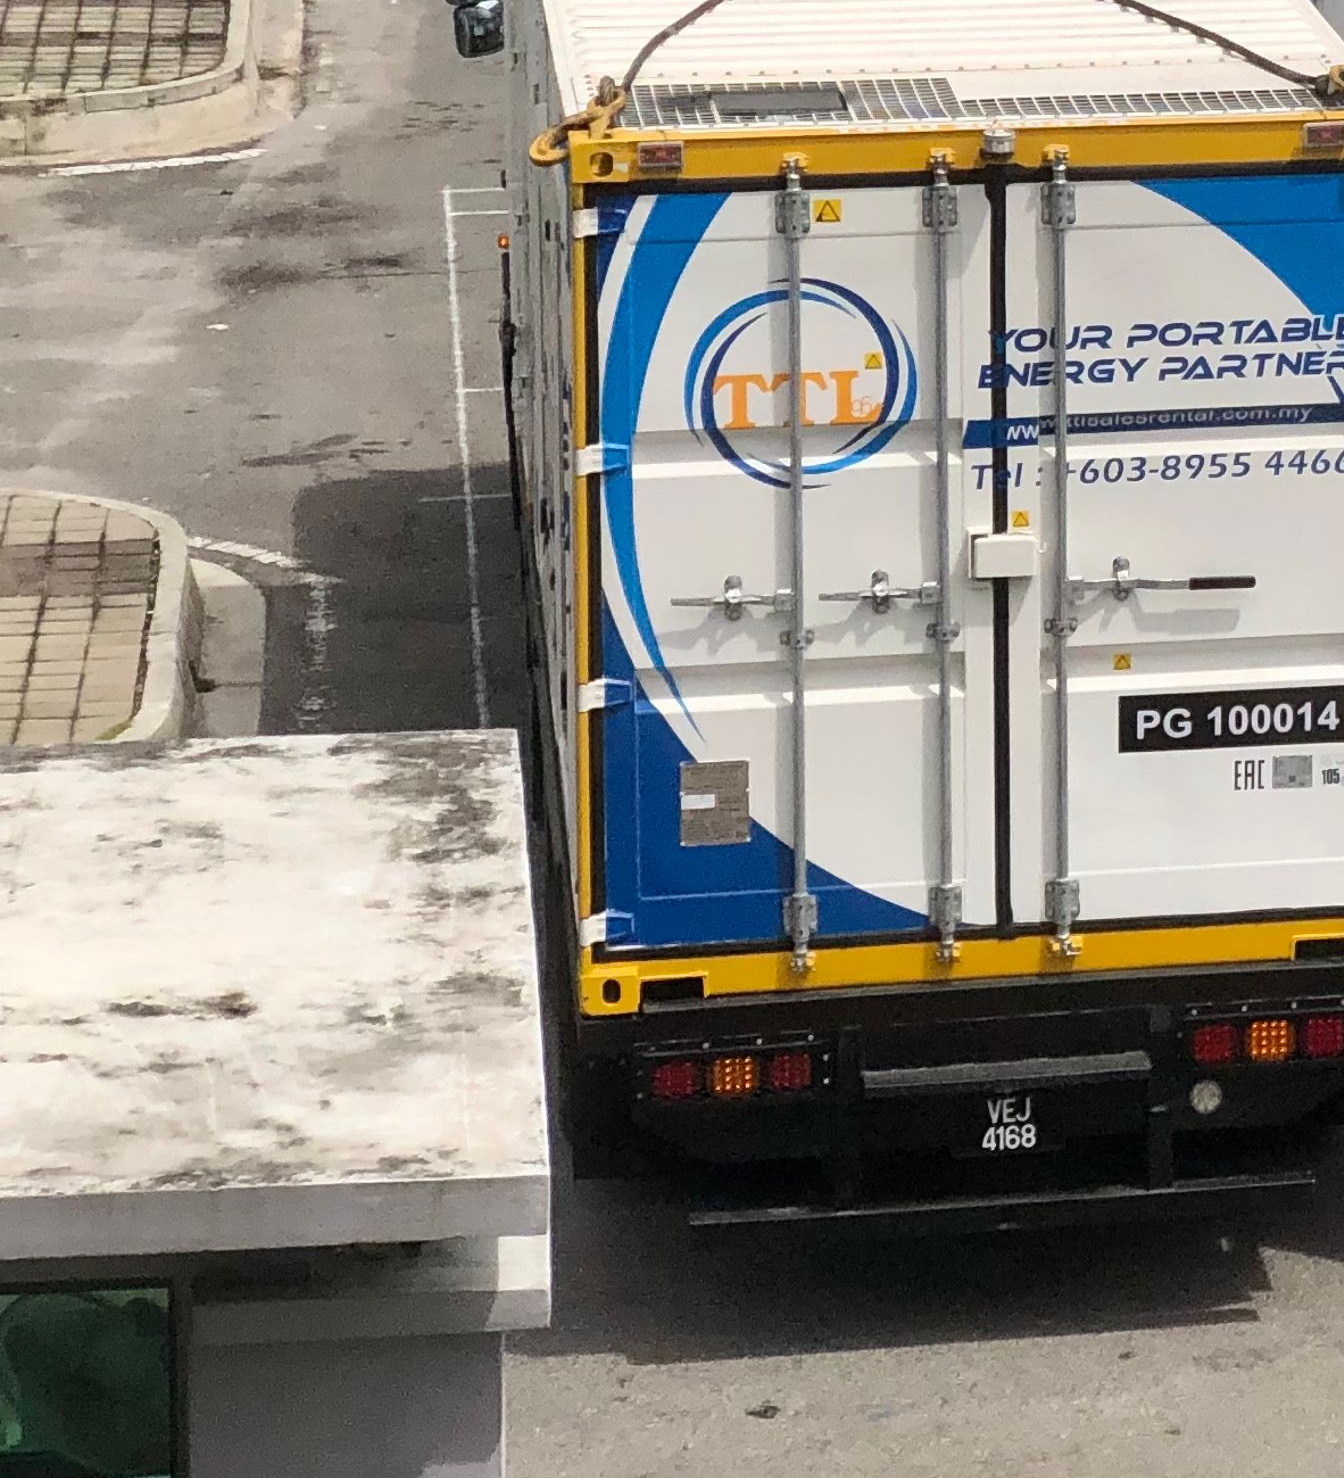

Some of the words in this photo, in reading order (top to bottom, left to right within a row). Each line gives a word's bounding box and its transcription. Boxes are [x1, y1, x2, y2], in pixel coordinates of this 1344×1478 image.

[978, 357, 1149, 389] ENERGY
[712, 370, 889, 430] TTL
[1136, 707, 1193, 741] PG
[1206, 700, 1340, 737] 100014
[1233, 759, 1265, 791] EAC
[986, 1097, 1032, 1124] VEJ
[981, 1123, 1037, 1152] 4168
